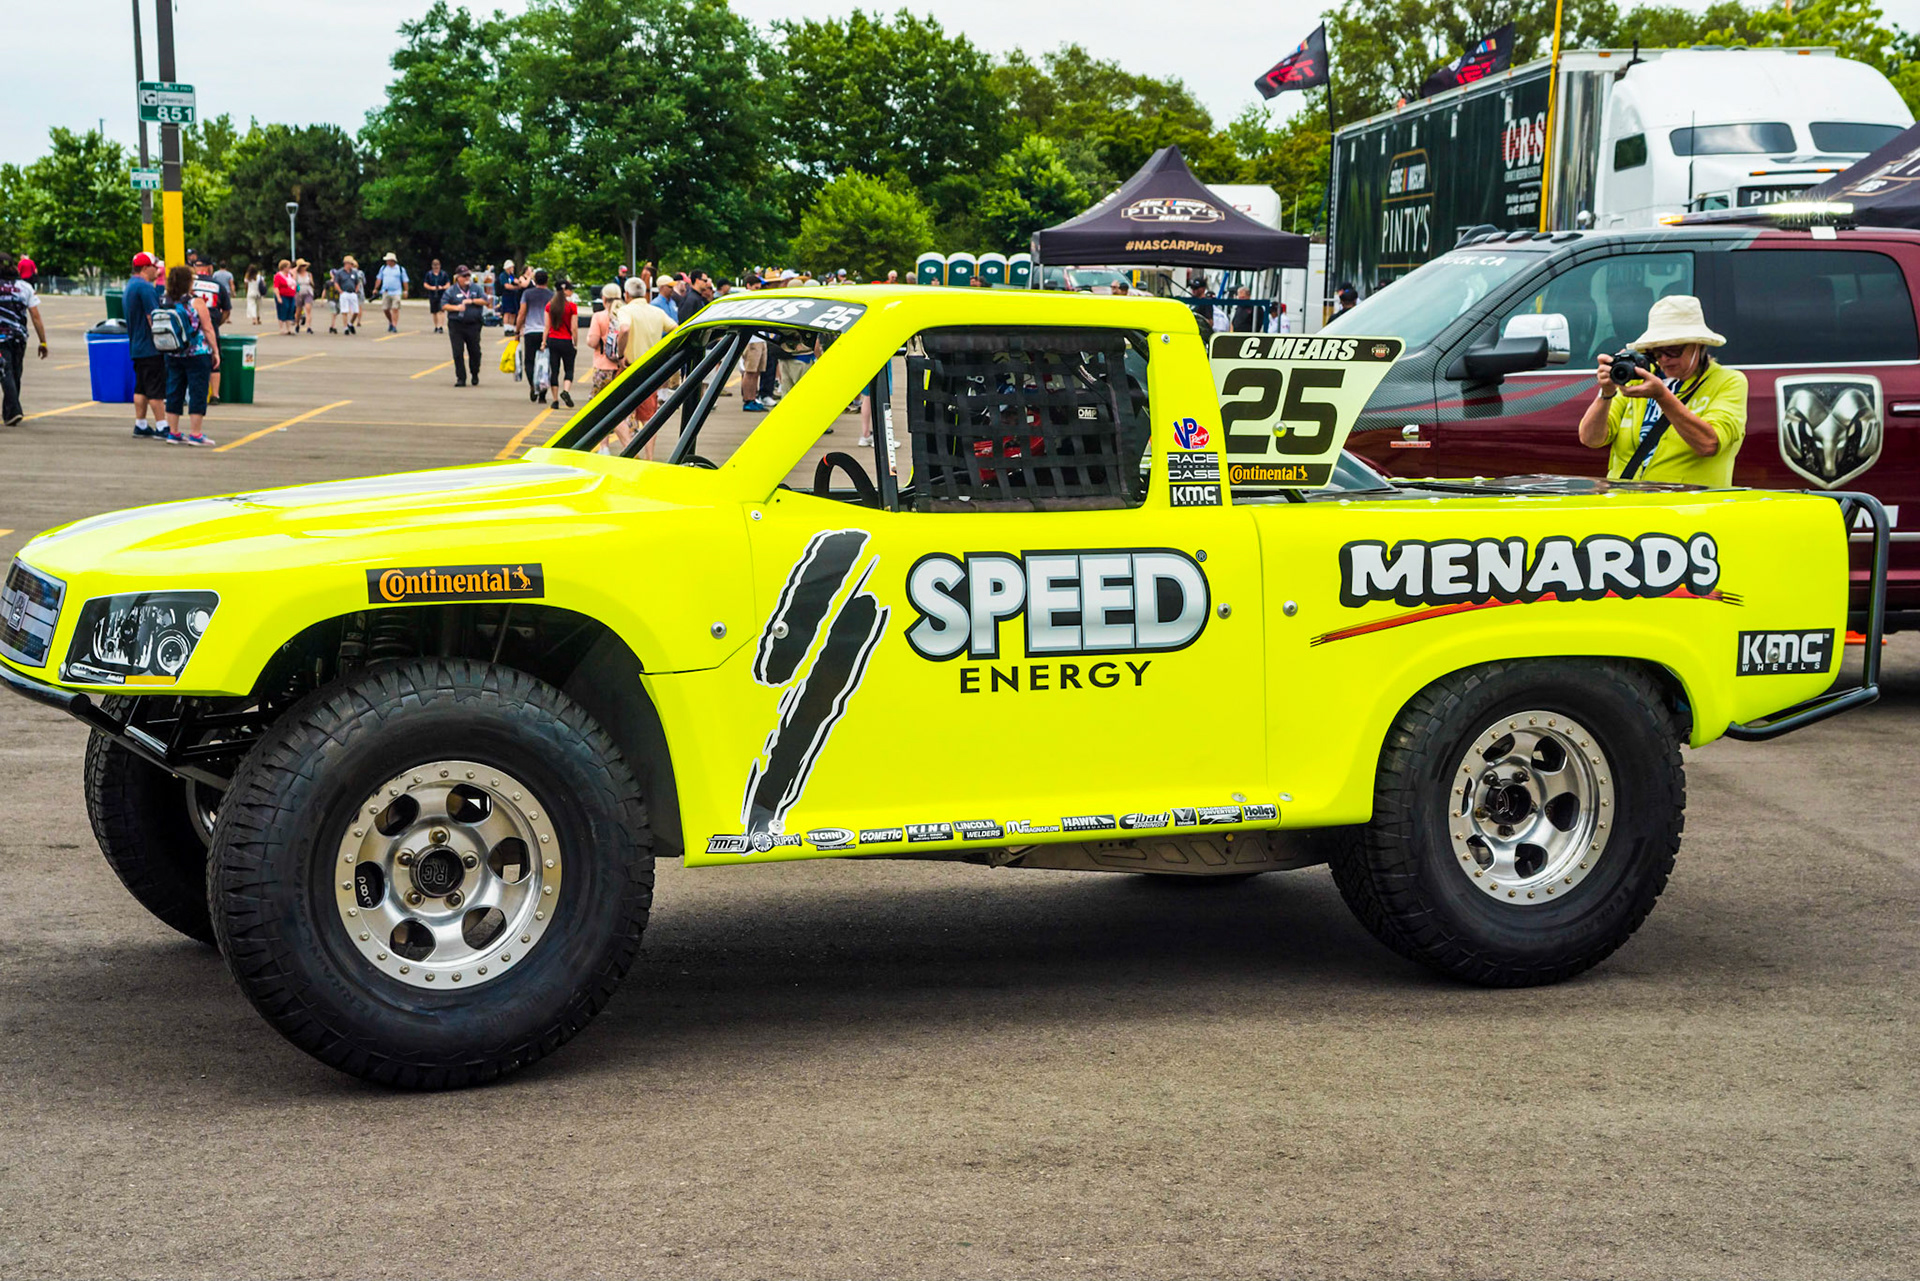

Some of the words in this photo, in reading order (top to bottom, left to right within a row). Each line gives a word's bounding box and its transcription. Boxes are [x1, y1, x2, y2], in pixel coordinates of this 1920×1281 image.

[158, 106, 194, 121] 851
[1127, 206, 1220, 219] PINTY'S
[1381, 203, 1430, 253] PINTY'S
[1125, 240, 1224, 255] #NASCARPintys
[809, 305, 864, 331] 25
[1239, 337, 1261, 359] C.
[1267, 338, 1358, 361] MEARS
[1077, 408, 1097, 418] OMP
[1220, 368, 1346, 455] 25
[1173, 418, 1198, 449] VP
[1168, 454, 1218, 463] RACE
[1169, 470, 1220, 479] CASE
[1230, 464, 1298, 484] Continental
[1172, 486, 1217, 502] KMC
[1343, 533, 1720, 605] MENARDS
[379, 569, 512, 602] Continental
[907, 550, 1209, 660] SPEED
[1742, 633, 1824, 664] KMC
[1742, 662, 1820, 672] WHEELS
[960, 660, 1152, 694] ENERGY
[1125, 811, 1170, 825] Eibach
[1243, 806, 1276, 818] Holley
[908, 823, 951, 834] KING
[955, 820, 995, 830] LINCOLN
[1062, 816, 1098, 827] HAWK
[808, 831, 842, 841] TECHNI
[860, 830, 902, 841] COMETIC
[966, 829, 1001, 838] WELDERS
[709, 838, 746, 849] MPI
[772, 835, 801, 847] SUPPLY
